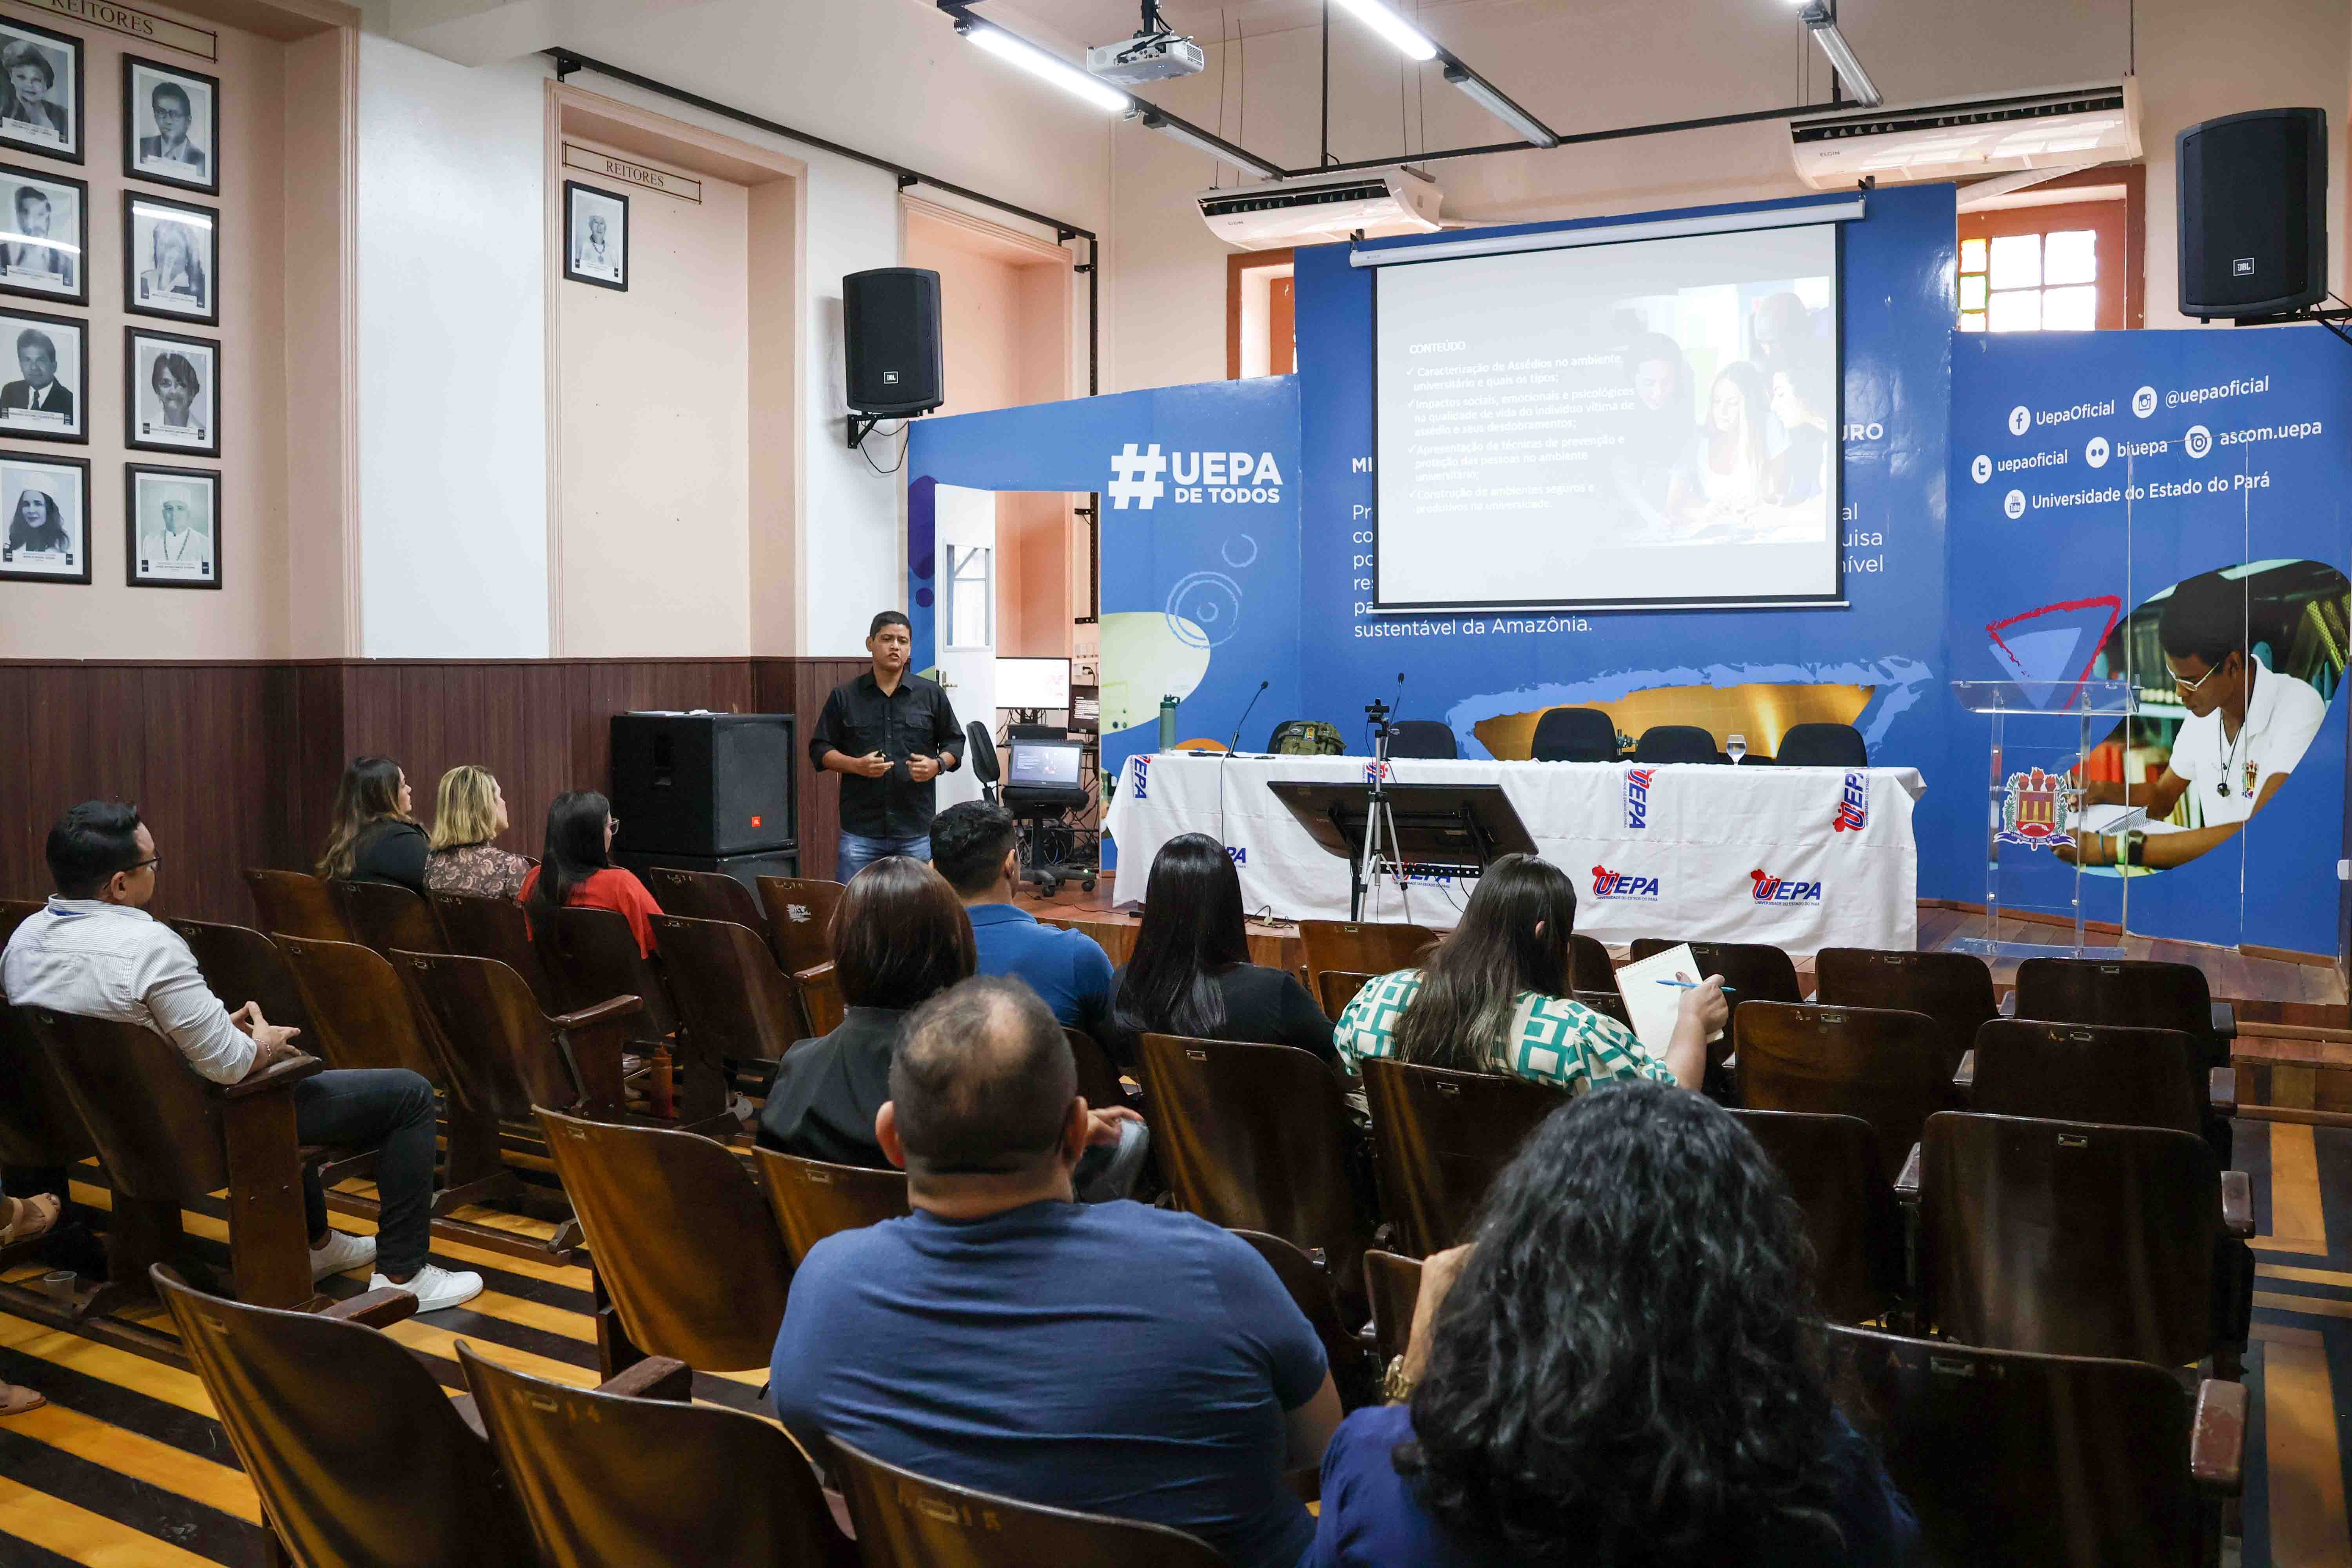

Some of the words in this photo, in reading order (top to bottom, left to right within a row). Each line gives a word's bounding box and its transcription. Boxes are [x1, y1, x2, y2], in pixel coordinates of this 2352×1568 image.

[606, 160, 664, 187] REITORES
[2238, 262, 2251, 271] JBL
[1409, 339, 1466, 354] CONTEÚDO
[1417, 363, 1490, 376] Caracterização
[1492, 361, 1506, 373] de
[1508, 358, 1552, 371] Assédios
[1555, 358, 1568, 367] no
[1571, 354, 1622, 367] ambiente
[1414, 377, 1474, 392] universitário
[1486, 374, 1514, 389] quais
[1516, 375, 1527, 384] os
[1530, 373, 1559, 386] tipos;
[2165, 375, 2269, 408] @uepaoficial
[1416, 399, 1463, 411] Impactos
[1464, 394, 1499, 407] sociais,
[1502, 391, 1559, 404] emocionais
[1561, 392, 1568, 401] e
[1571, 386, 1634, 402] psicológicos
[1414, 413, 1426, 423] na
[1429, 410, 1477, 423] qualidade
[1480, 408, 1493, 420] de
[1495, 407, 1517, 418] vida
[1519, 405, 1533, 417] do
[1586, 400, 1619, 413] vítima
[1621, 399, 1634, 410] de
[2036, 399, 2114, 426] UepaOficial
[1414, 424, 1451, 436] assédio
[1453, 426, 1459, 434] e
[1461, 425, 1485, 434] seus
[1487, 420, 1578, 432] desdobramentos;
[2220, 421, 2322, 445] ascom.uepa
[1417, 442, 1484, 456] Apresentação
[1486, 441, 1499, 451] de
[1502, 438, 1543, 450] técnicas
[1546, 436, 1559, 448] de
[1561, 433, 1615, 449] prevenção
[1618, 436, 1625, 446] e
[1415, 457, 1459, 470] proteção
[1461, 455, 1478, 465] das
[1480, 454, 1521, 467] pessoas
[1523, 454, 1537, 464] no
[1539, 450, 1589, 461] ambiente
[1998, 449, 2068, 473] uepaoficial
[1415, 468, 1480, 483] universitário;
[1175, 488, 1203, 503] DE
[1207, 488, 1280, 503] TODOS
[1417, 488, 1471, 499] Construção
[1475, 486, 1487, 496] de
[1490, 485, 1543, 496] ambientes
[1546, 484, 1587, 496] seguros
[1588, 484, 1595, 493] e
[2033, 487, 2121, 509] Universidade
[2125, 485, 2145, 501] do
[2149, 479, 2202, 498] Estado
[2207, 476, 2229, 492] do
[2234, 471, 2270, 490] Pará
[1416, 501, 1468, 514] produtivos
[1470, 502, 1484, 512] na
[1354, 619, 1455, 637] sustentável
[1462, 619, 1485, 634] da
[1492, 616, 1592, 634] Amazônia.
[1135, 755, 1148, 799] EPA
[1629, 769, 1646, 828] UEPA
[1226, 846, 1246, 863] PA
[1595, 876, 1659, 896] UEPA
[1755, 880, 1821, 900] UEPA
